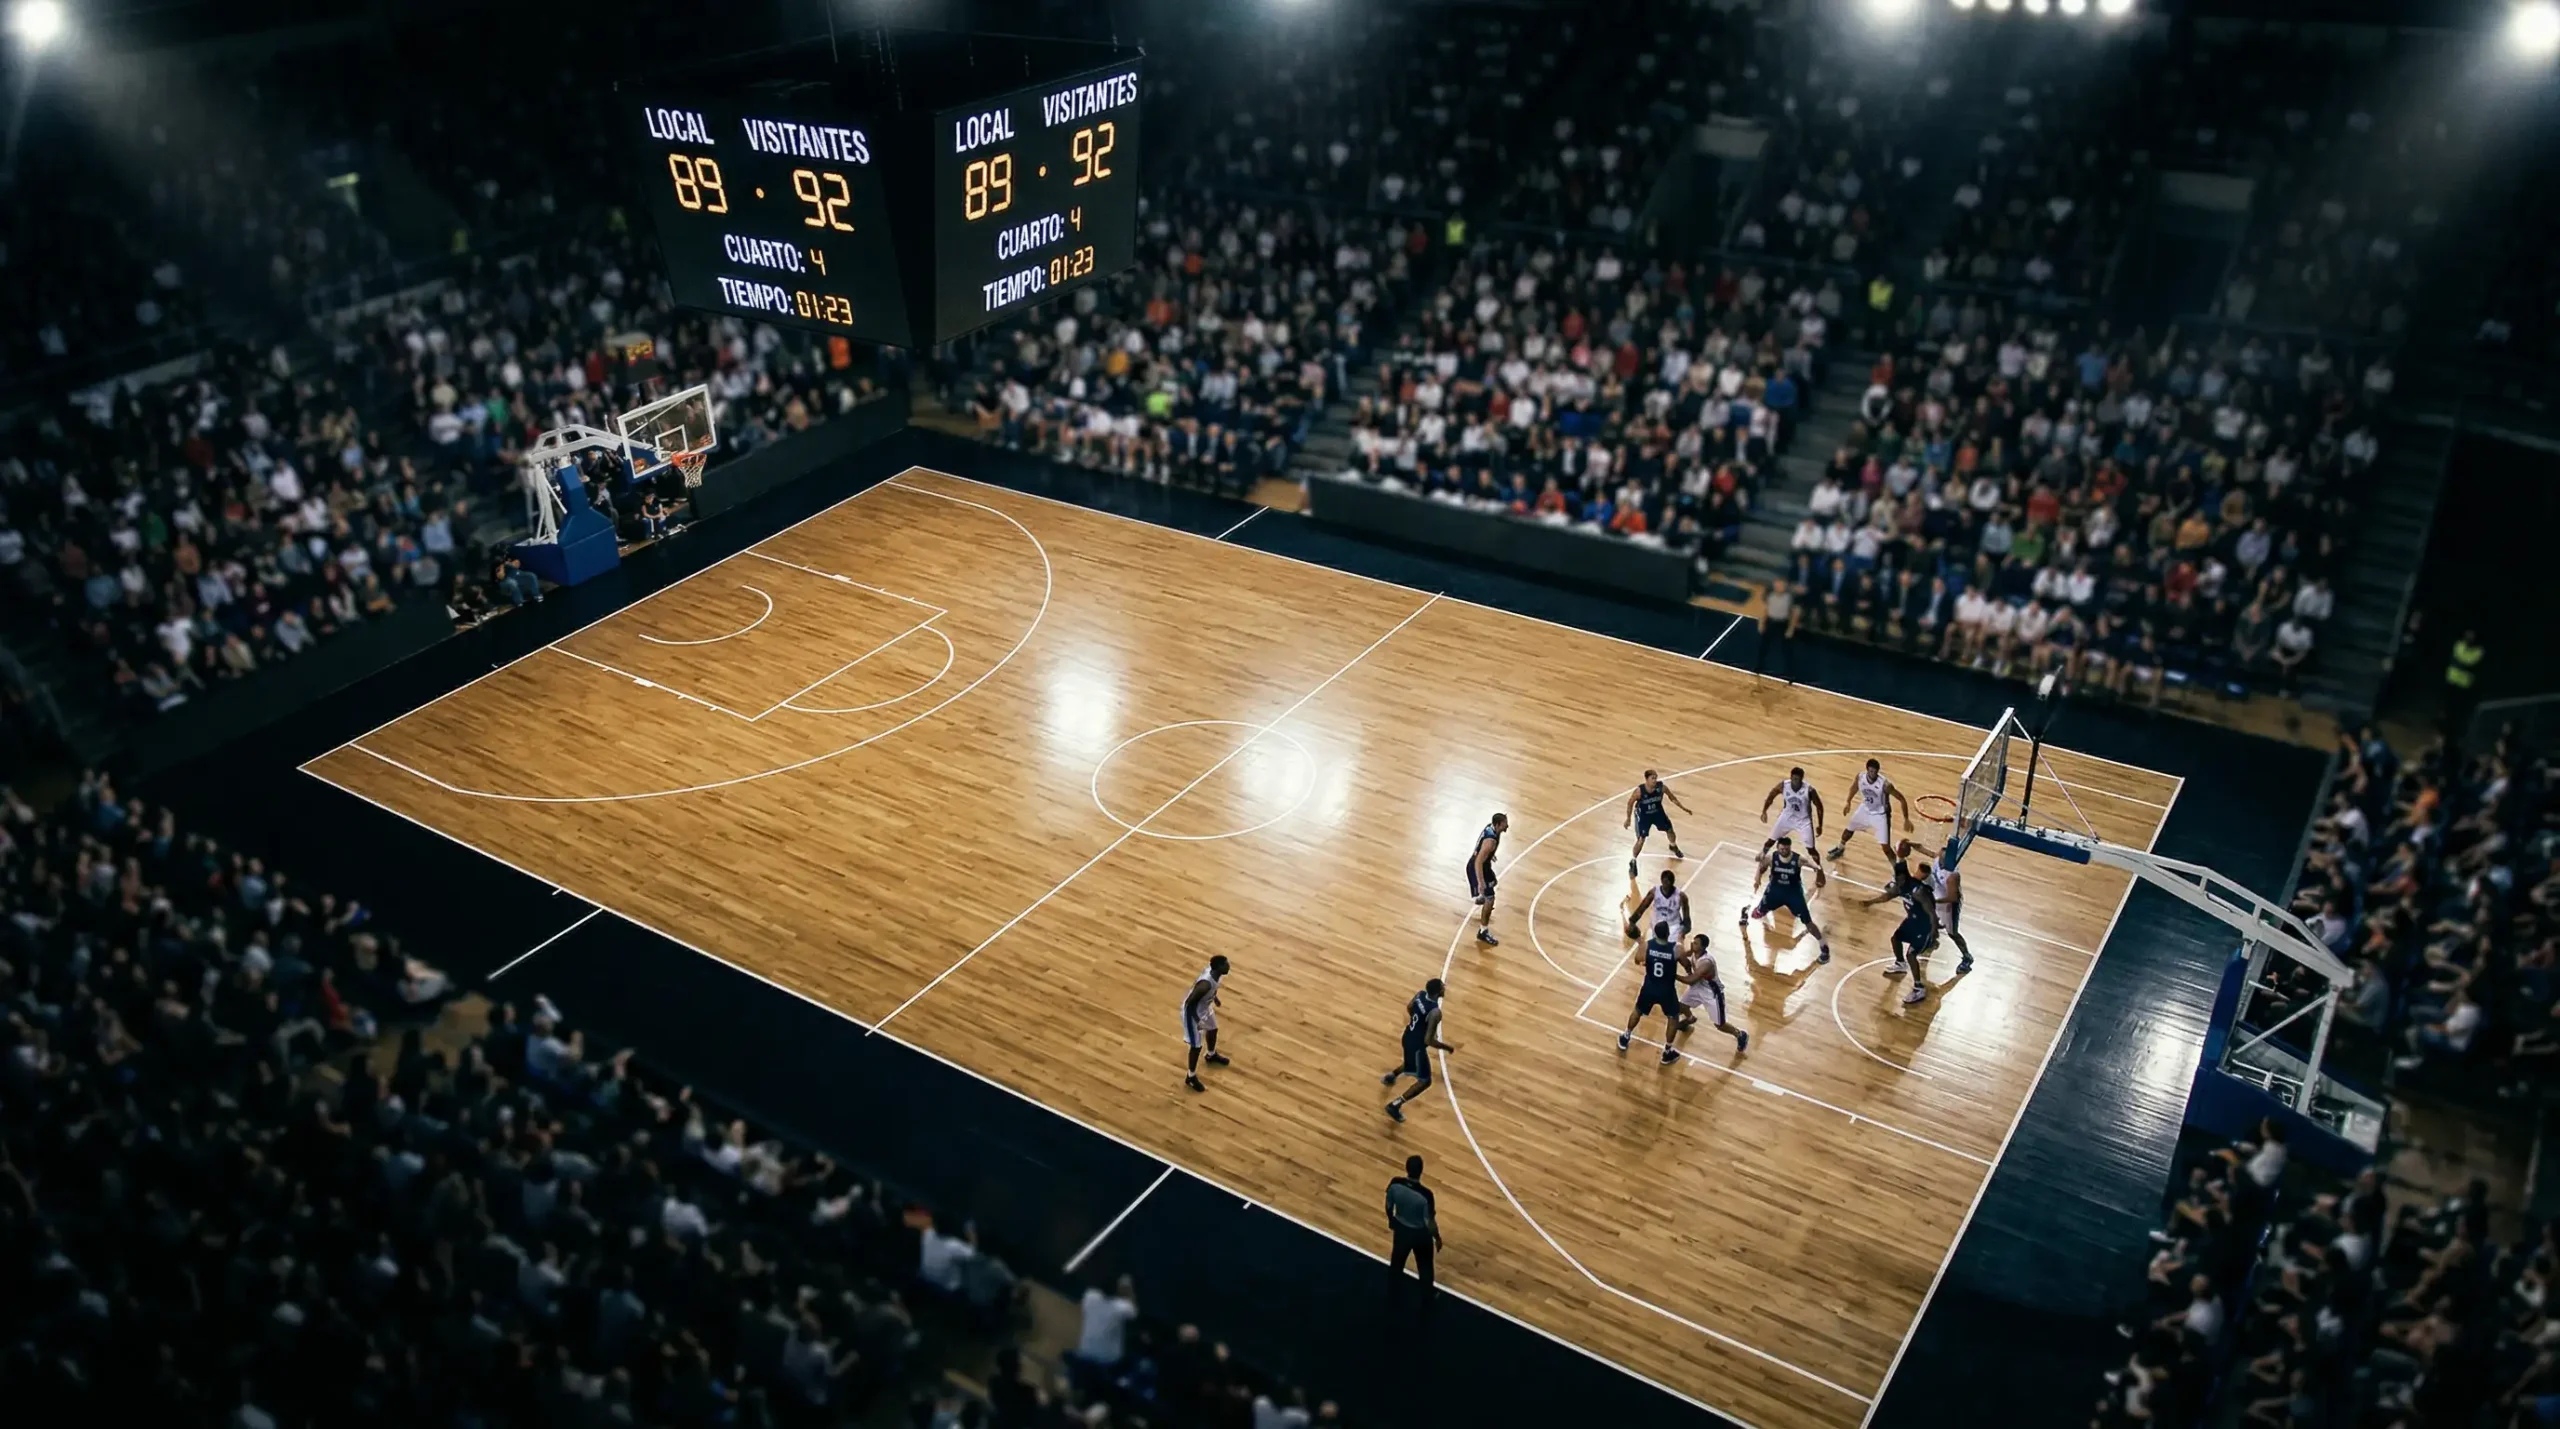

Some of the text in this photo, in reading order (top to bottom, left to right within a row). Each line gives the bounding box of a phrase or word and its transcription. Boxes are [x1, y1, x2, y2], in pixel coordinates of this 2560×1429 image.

[645, 107, 870, 164] LOCAL VISITANTES
[955, 72, 1137, 153] LOCAL VISITANTES
[668, 153, 855, 232] 89 92
[965, 121, 1115, 221] 89 92
[724, 234, 826, 276] CUARTO: 4
[998, 206, 1081, 260] CUARTO: 4
[717, 277, 853, 325] TIEMPO: 01:23
[983, 245, 1094, 312] TIEMPO: 01:23
